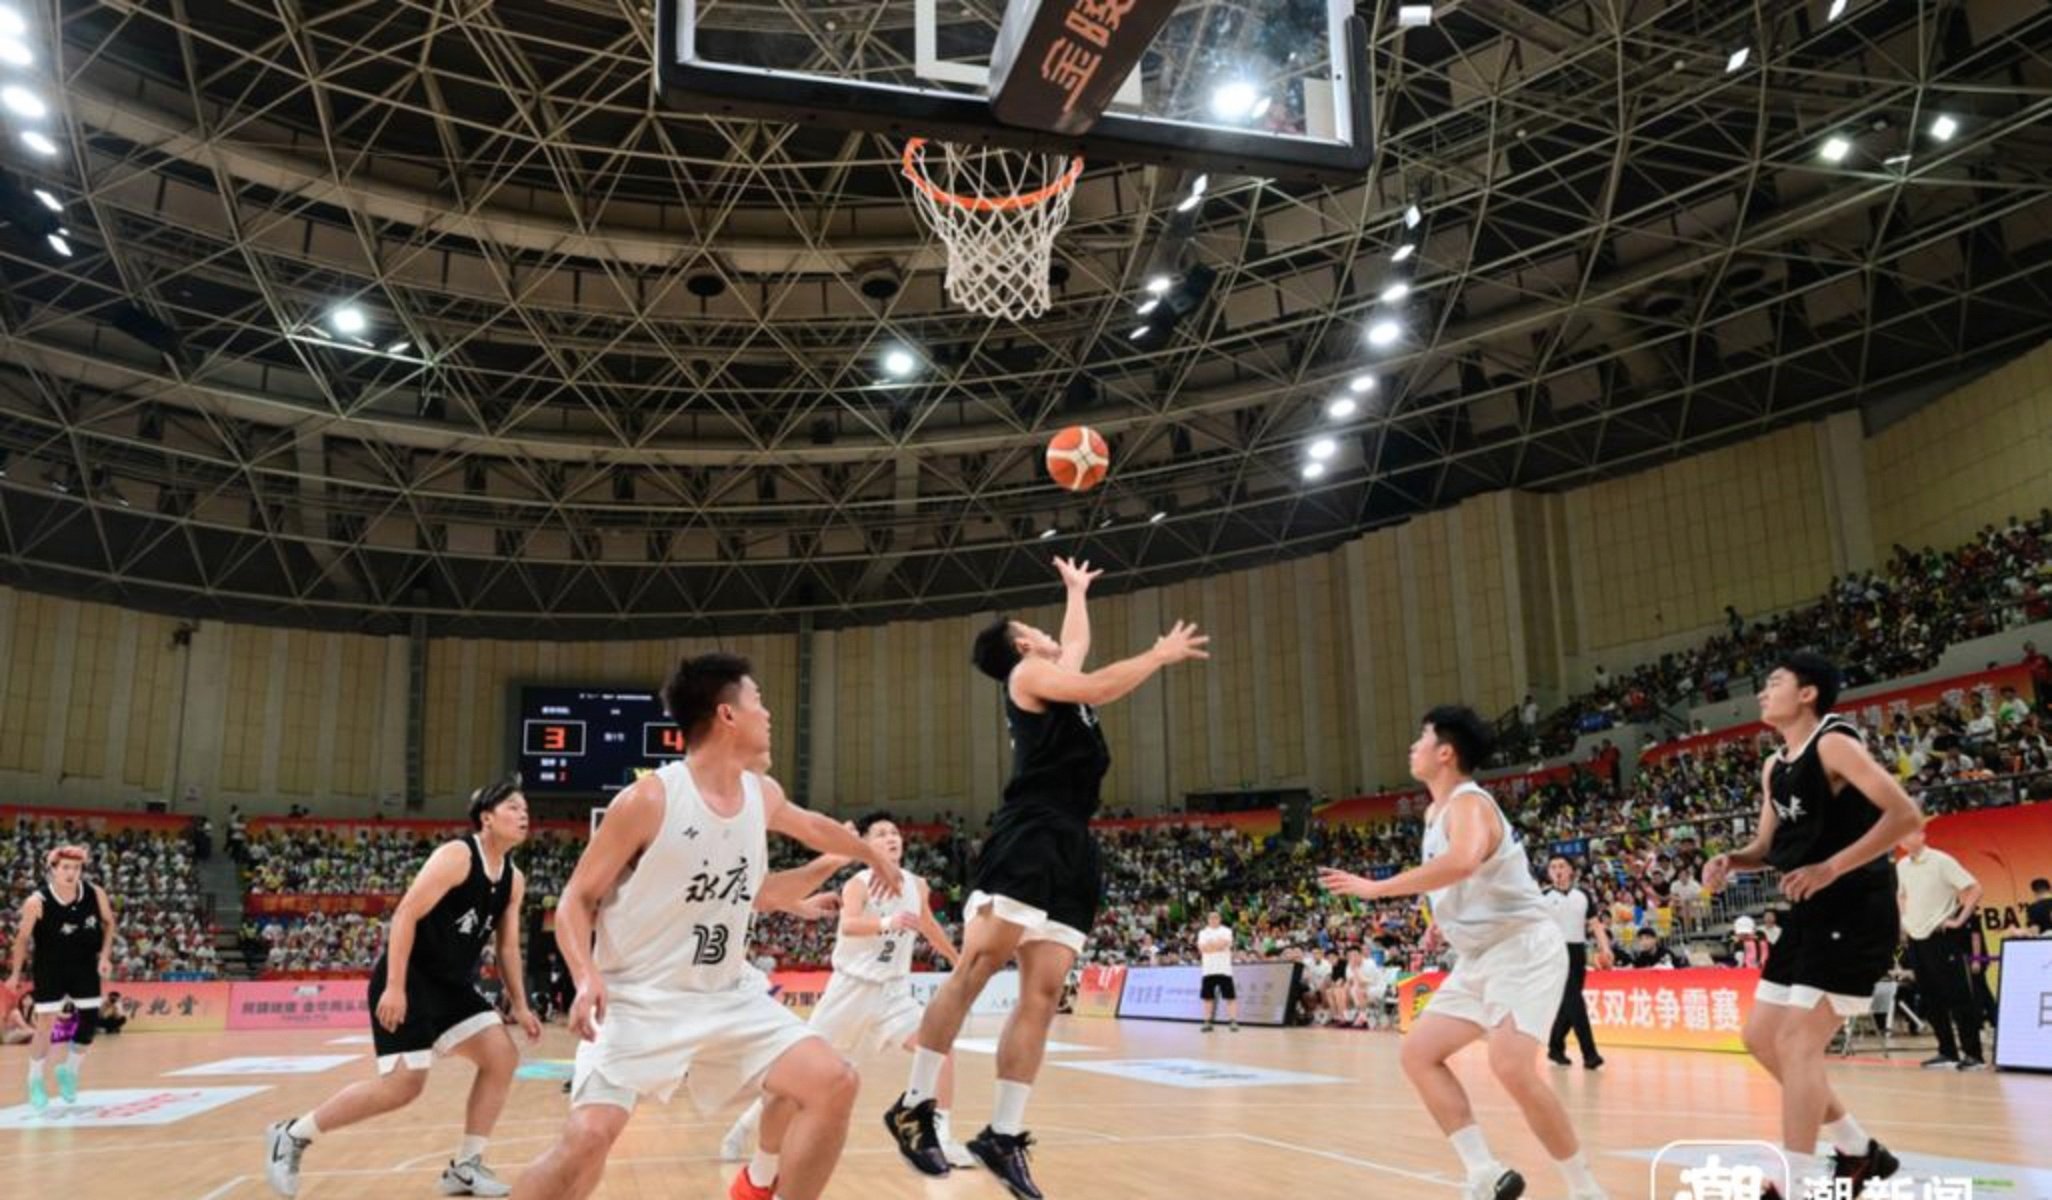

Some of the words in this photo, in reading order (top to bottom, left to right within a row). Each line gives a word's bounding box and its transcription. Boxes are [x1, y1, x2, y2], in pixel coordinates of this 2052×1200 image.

[544, 727, 566, 749] 3
[662, 730, 685, 751] 4
[692, 924, 729, 966] 13
[877, 941, 896, 962] 2
